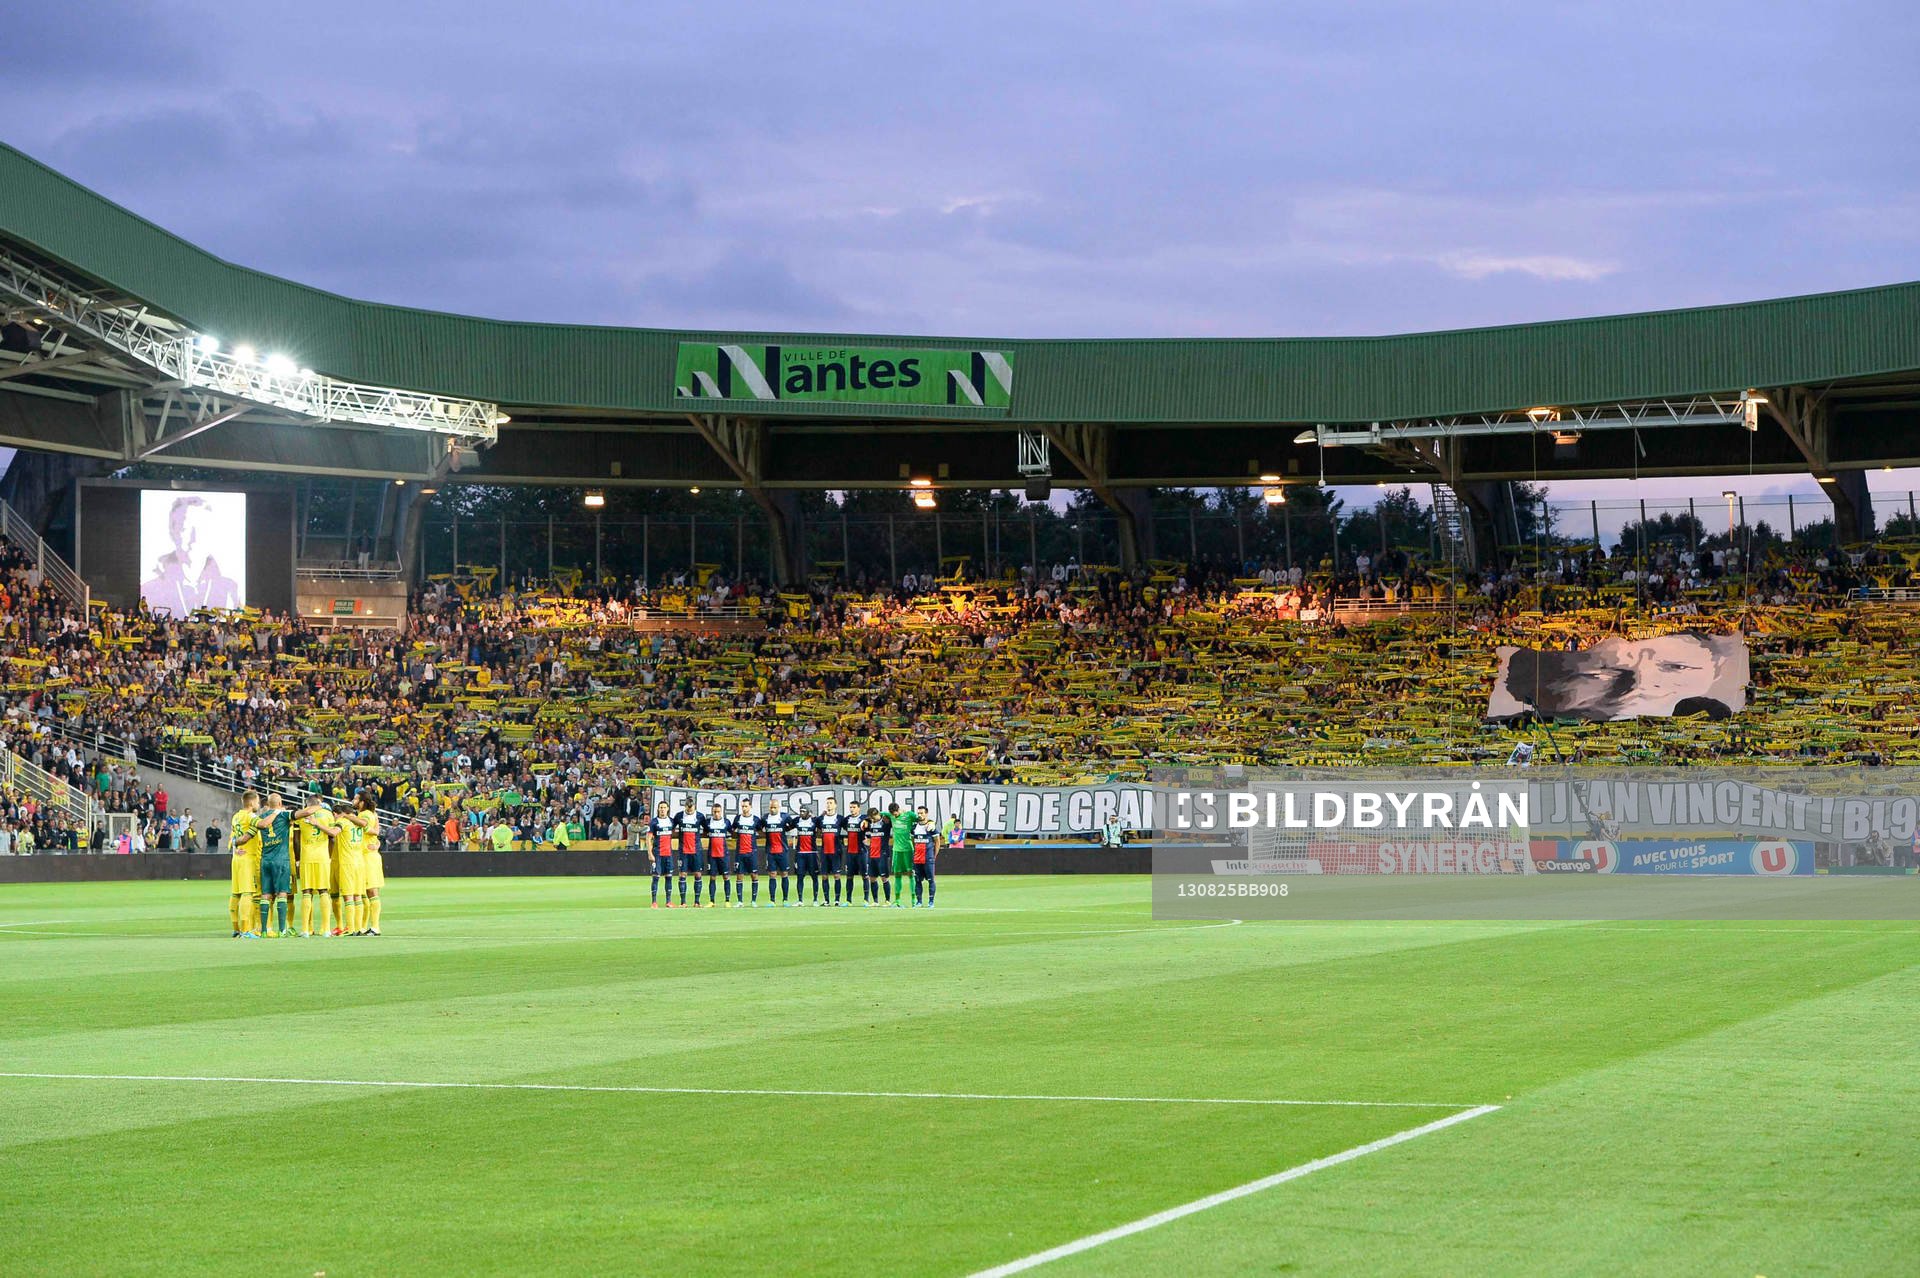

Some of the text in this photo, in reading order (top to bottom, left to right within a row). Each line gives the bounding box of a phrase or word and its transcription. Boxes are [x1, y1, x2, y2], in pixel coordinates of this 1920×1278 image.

[784, 350, 846, 362] VILLE DE
[1015, 789, 1060, 833] DE
[1551, 780, 1640, 825] JEAN
[1647, 780, 1814, 831] VINCENT
[350, 827, 363, 843] 19
[1633, 844, 1707, 866] AVEC VOUS
[1655, 851, 1735, 872] POUR LE SPORT
[1761, 847, 1787, 872] U
